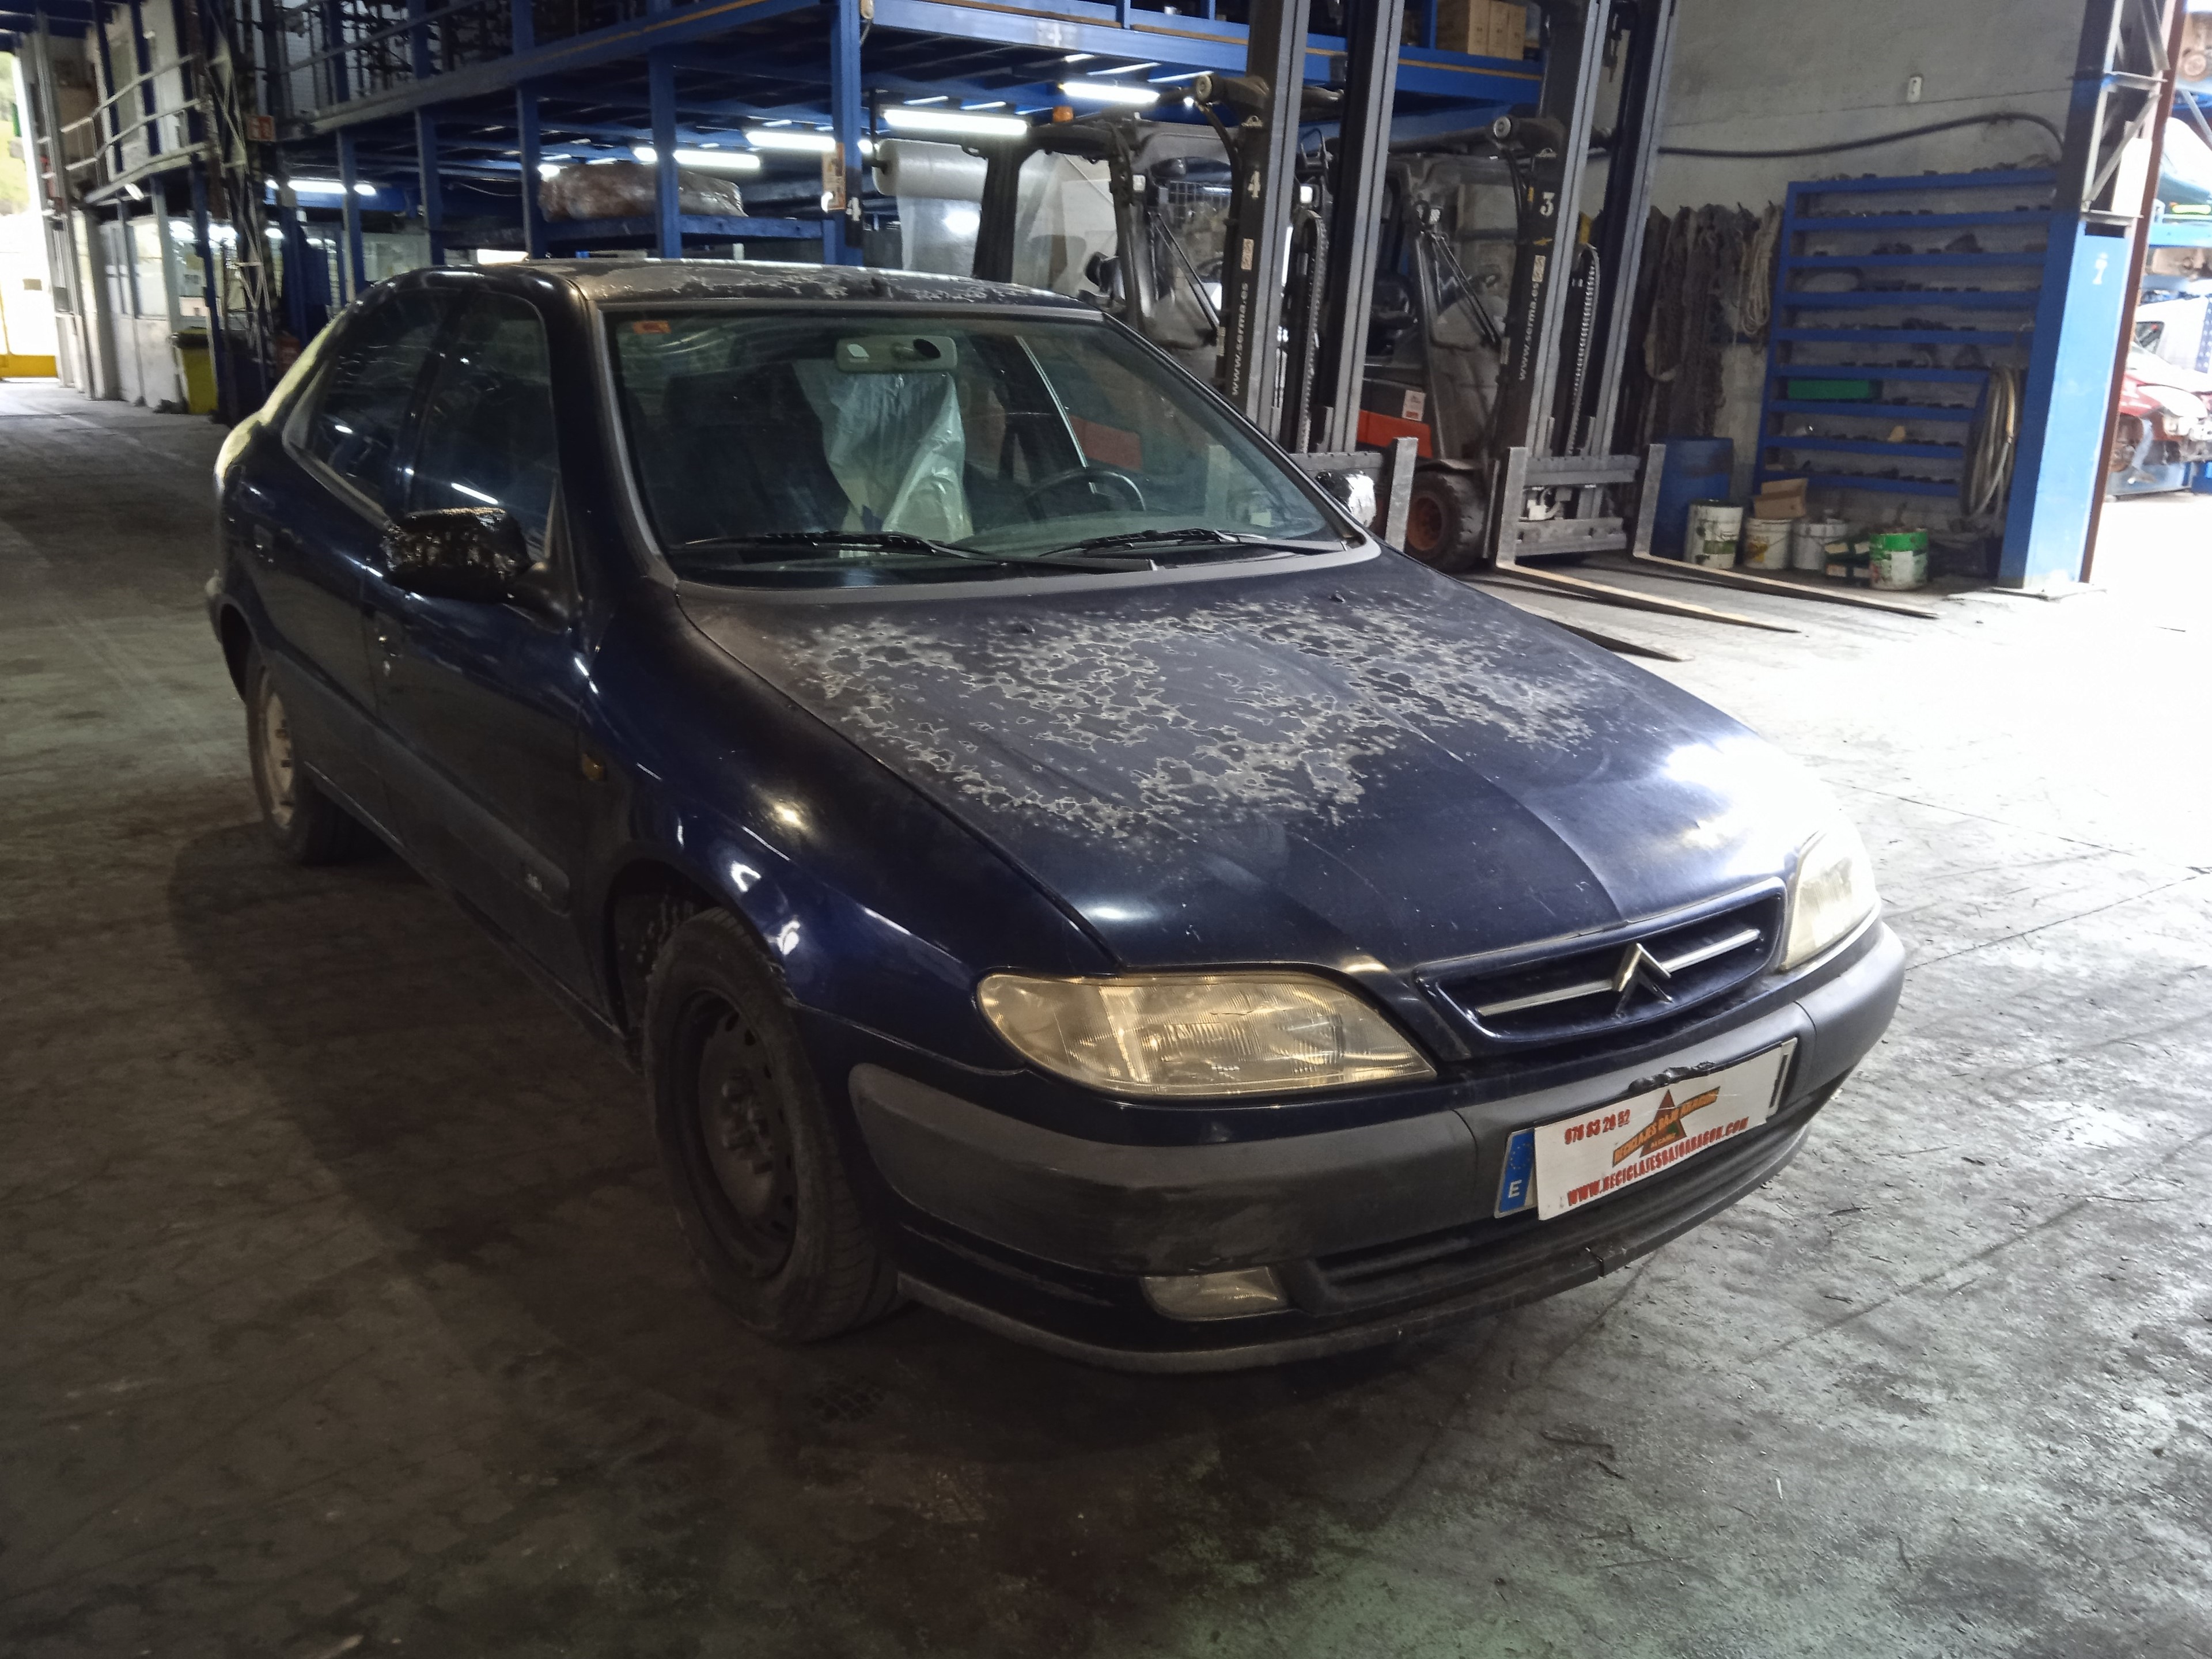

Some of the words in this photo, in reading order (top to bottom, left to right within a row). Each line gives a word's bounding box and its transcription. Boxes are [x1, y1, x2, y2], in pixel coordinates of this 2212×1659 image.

[1247, 171, 1261, 199] 4
[846, 197, 861, 221] 4
[1540, 191, 1555, 217] 3
[1232, 282, 1248, 396] www.serma.es
[1519, 282, 1539, 381] www.serma.es
[1618, 1109, 1631, 1127] 52
[1614, 1122, 1657, 1164] RECICLAJES
[1508, 1179, 1522, 1198] E
